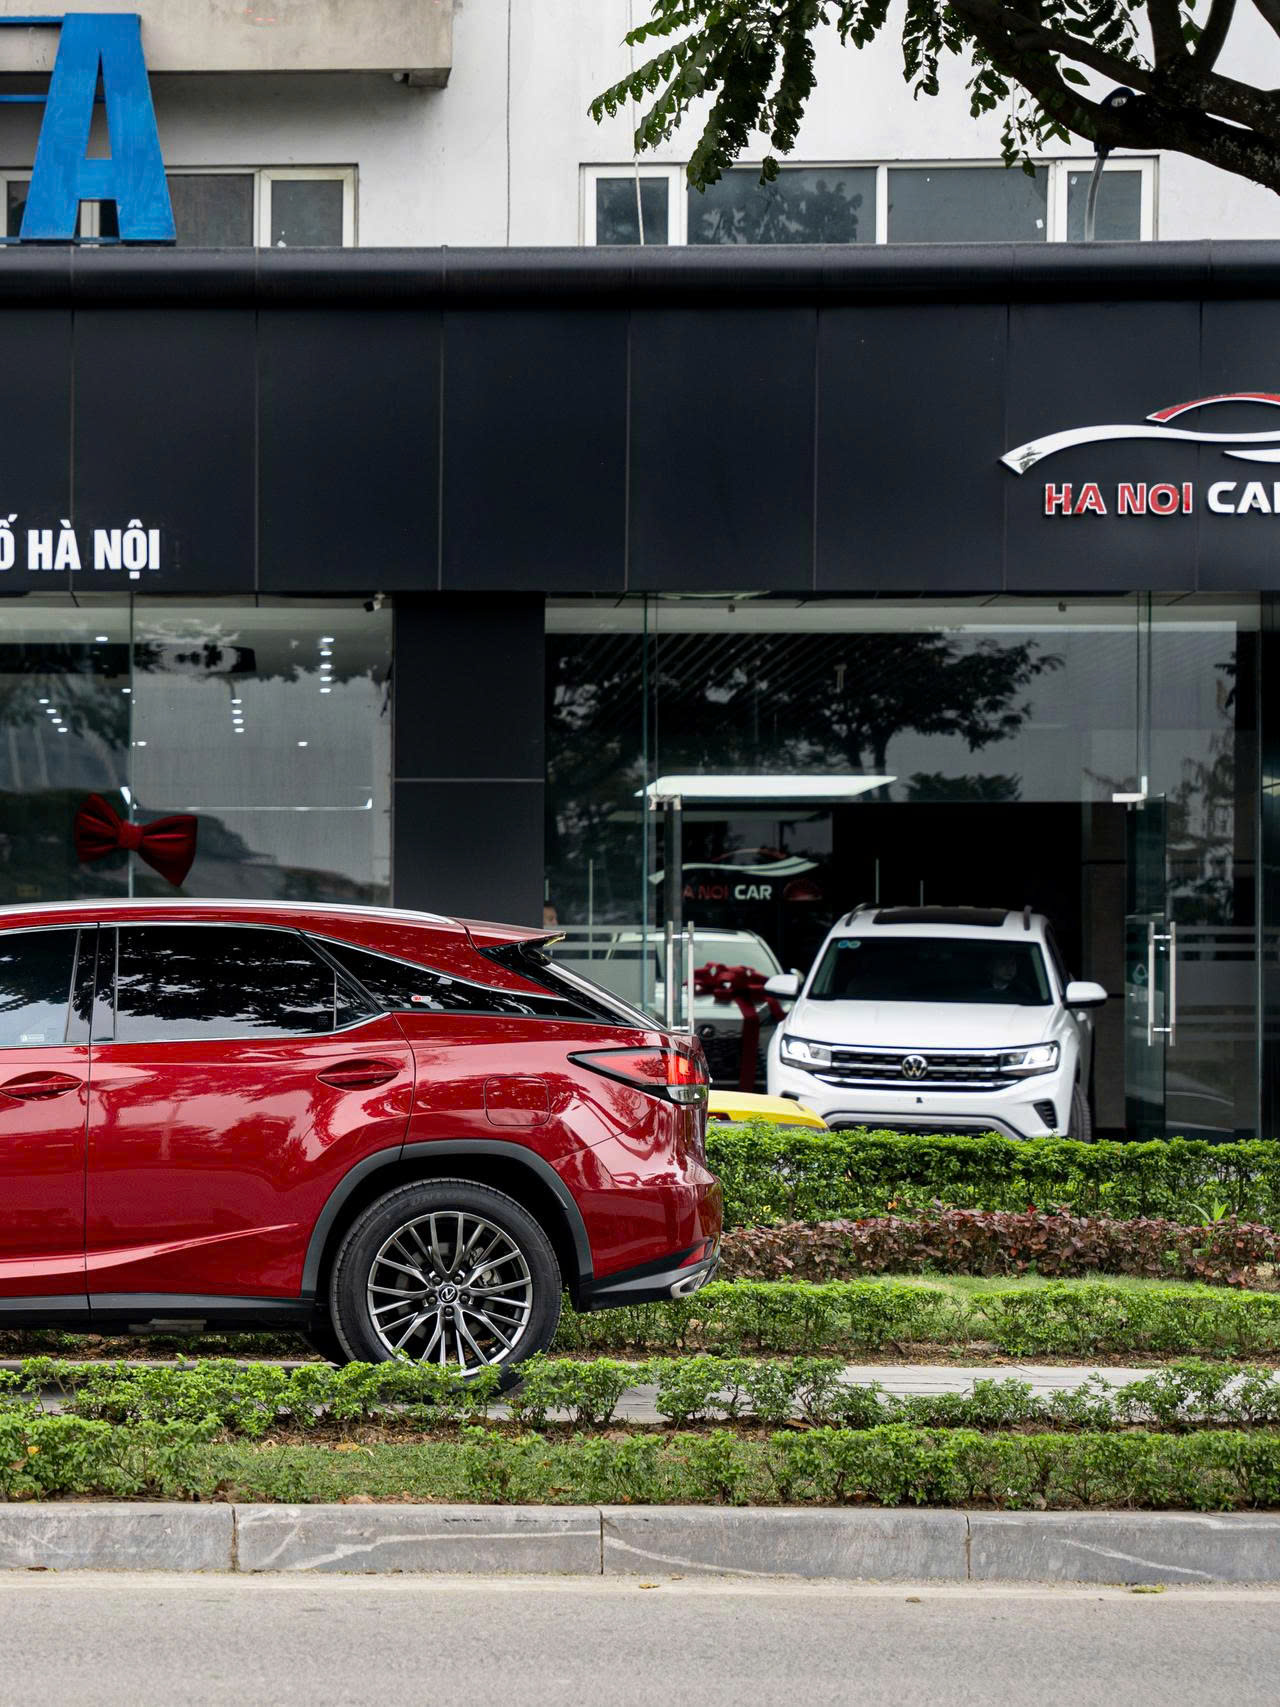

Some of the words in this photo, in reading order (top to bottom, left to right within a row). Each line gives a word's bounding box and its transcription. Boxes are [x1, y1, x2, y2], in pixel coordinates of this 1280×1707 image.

[1044, 482, 1108, 515] HA
[1117, 481, 1193, 515] NOI
[27, 518, 82, 571] HÀ
[93, 518, 160, 580] NỘI
[734, 883, 773, 901] CAR
